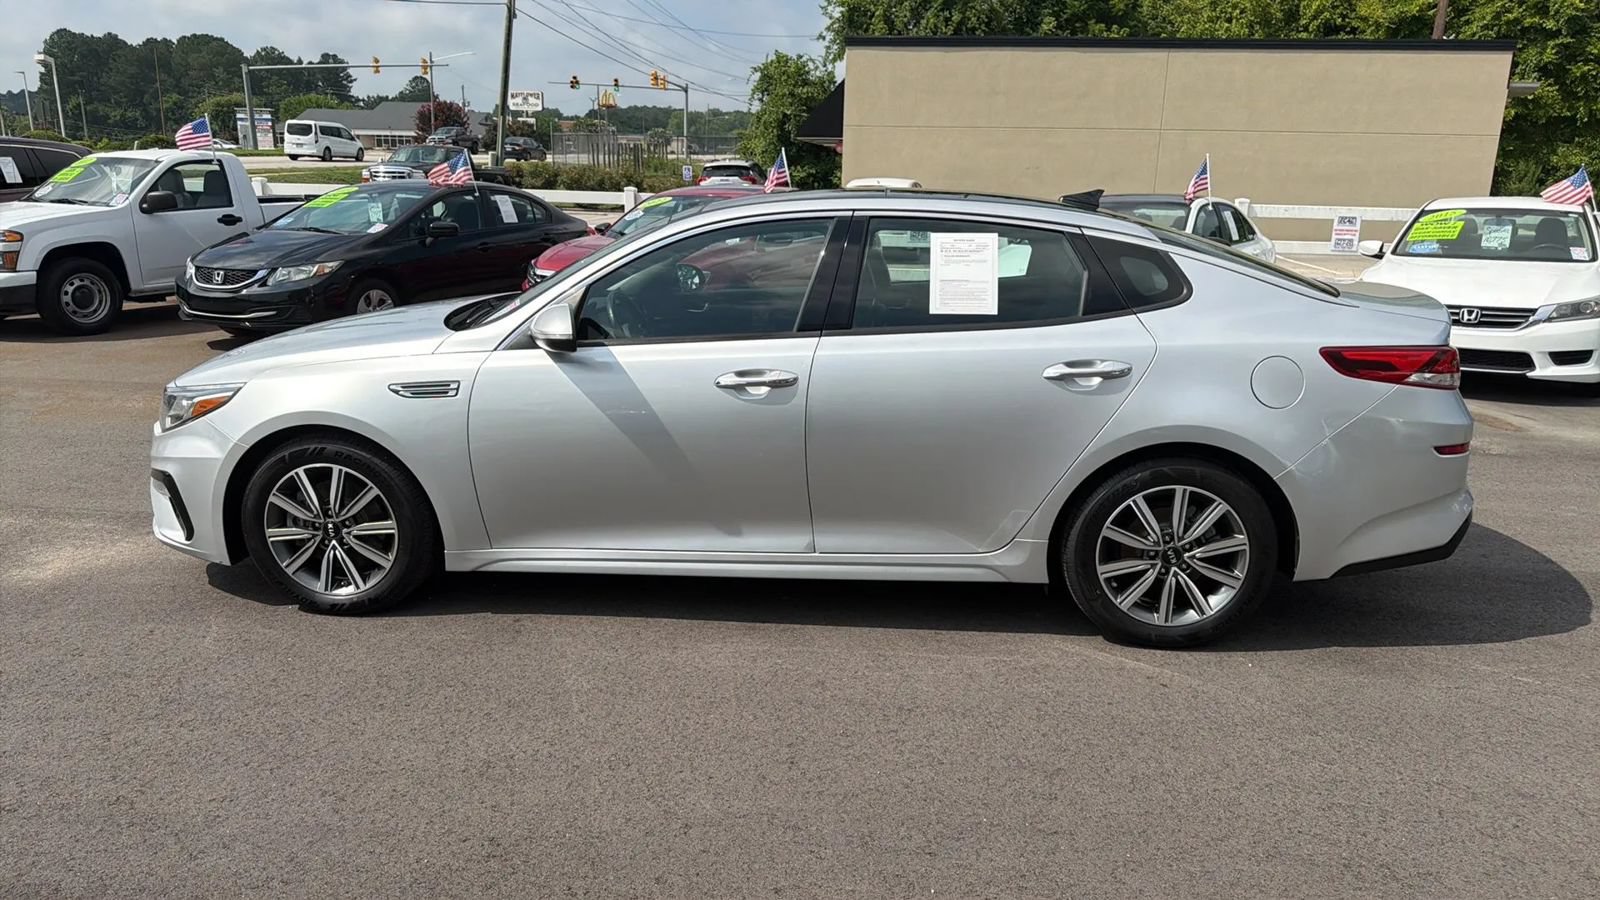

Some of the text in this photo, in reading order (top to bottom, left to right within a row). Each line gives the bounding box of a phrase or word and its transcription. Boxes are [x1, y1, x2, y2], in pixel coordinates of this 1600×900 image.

[511, 92, 540, 100] MAYFLOWER
[327, 523, 336, 538] KIA
[1167, 549, 1177, 564] KIA
